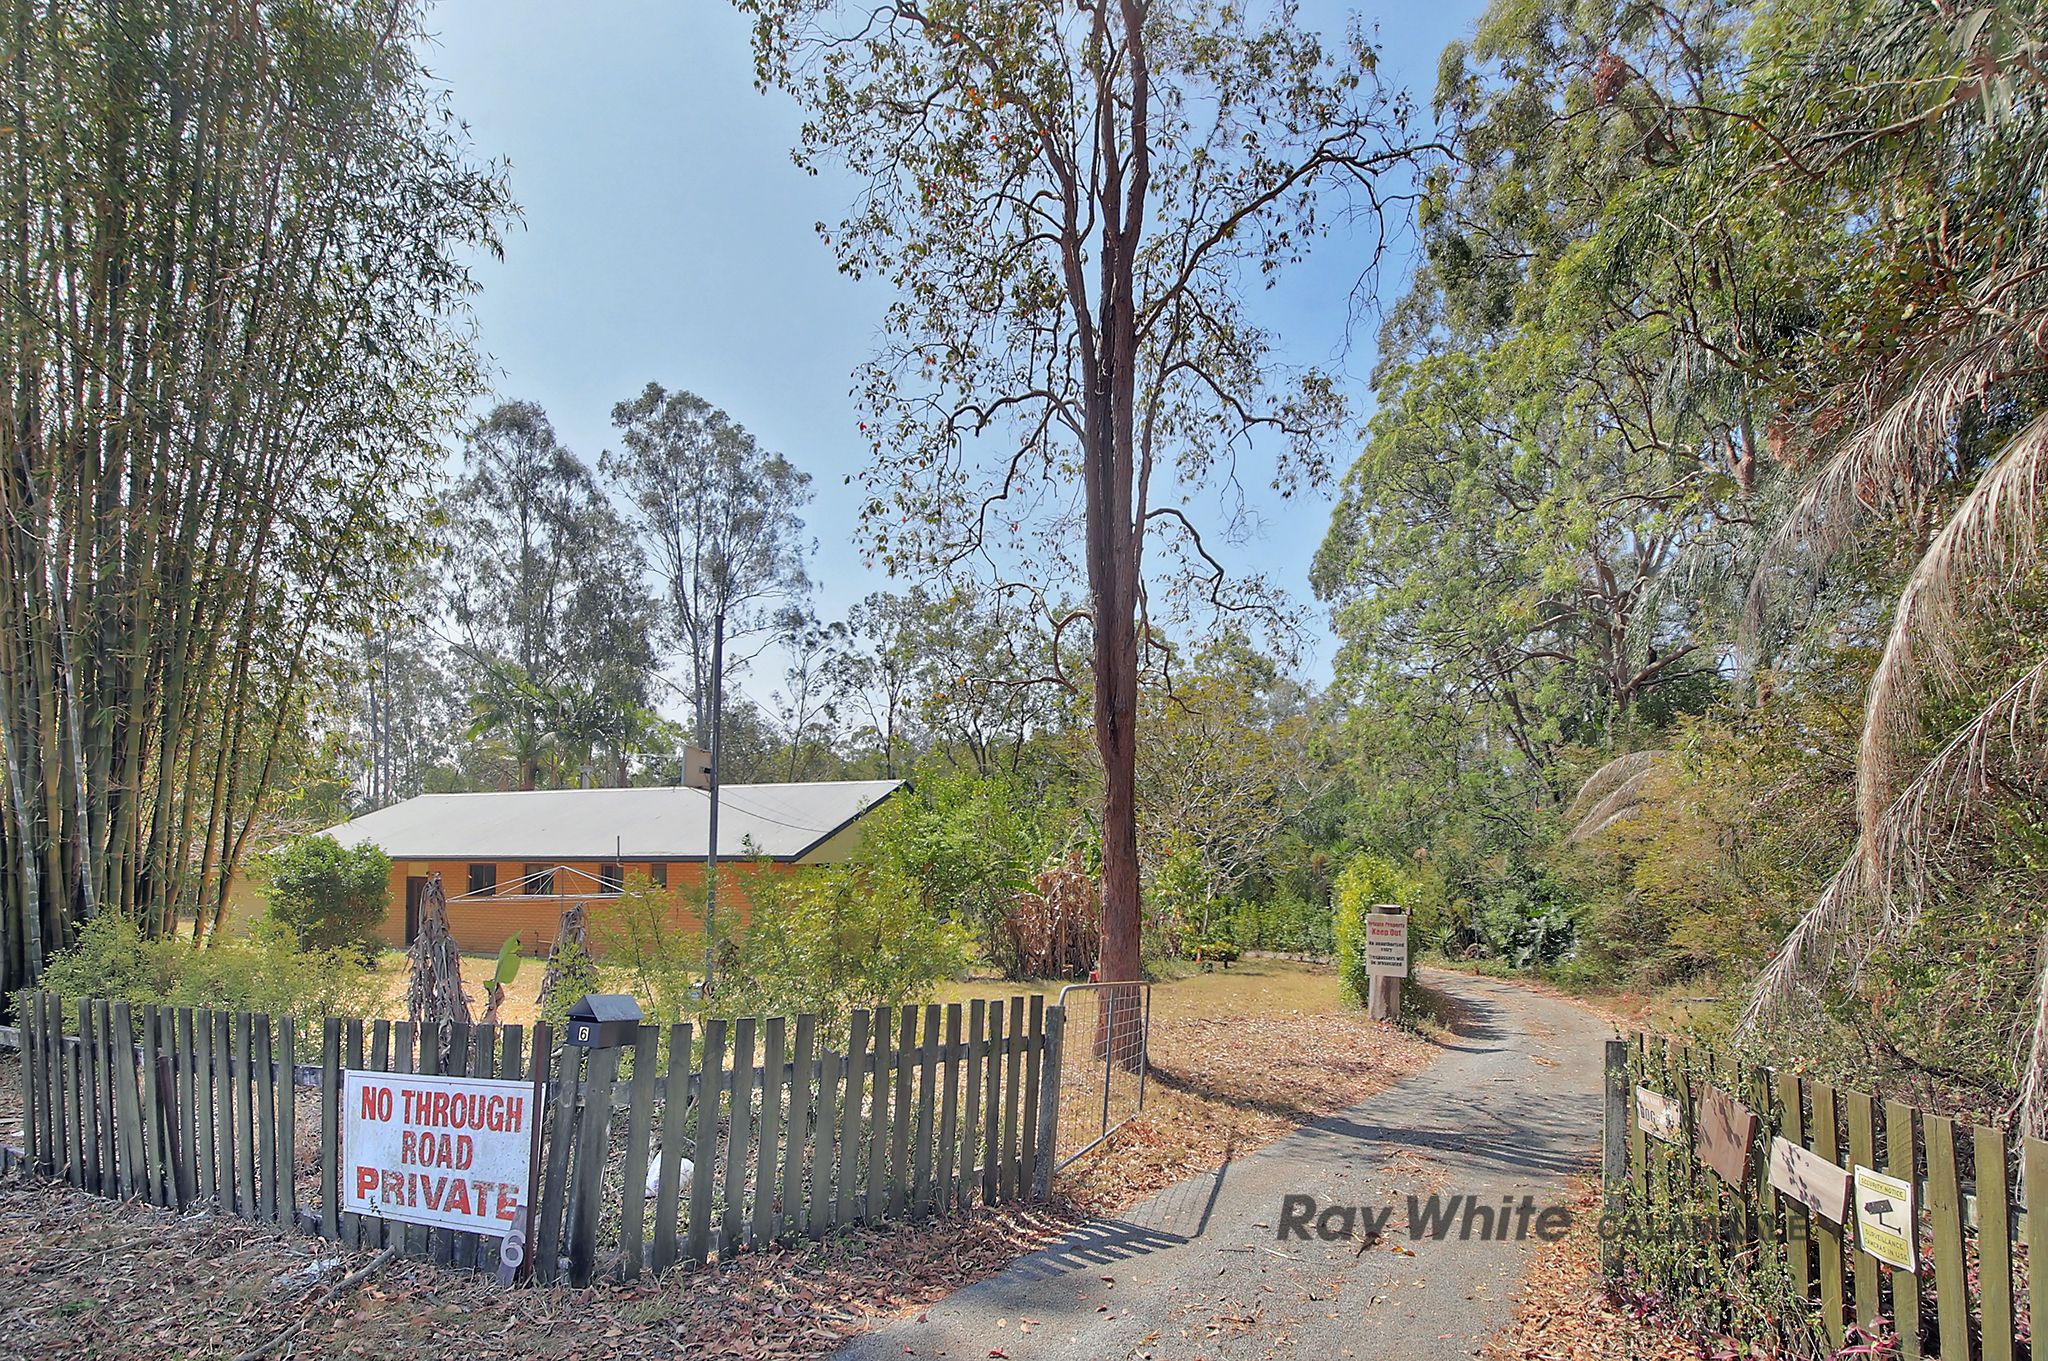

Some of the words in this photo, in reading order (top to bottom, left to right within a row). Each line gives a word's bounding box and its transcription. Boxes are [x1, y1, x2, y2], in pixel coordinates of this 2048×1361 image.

[1372, 928, 1389, 936] Keep
[580, 1028, 587, 1040] 6
[361, 1086, 393, 1122] NO
[401, 1089, 523, 1133] THROUGH
[401, 1130, 473, 1170] ROAD
[356, 1166, 520, 1221] PRIVATE
[1861, 1177, 1883, 1191] SECURITY
[1884, 1185, 1903, 1198] NOTICE
[500, 1230, 526, 1267] 6
[1865, 1228, 1904, 1250] SURVEILLANCE
